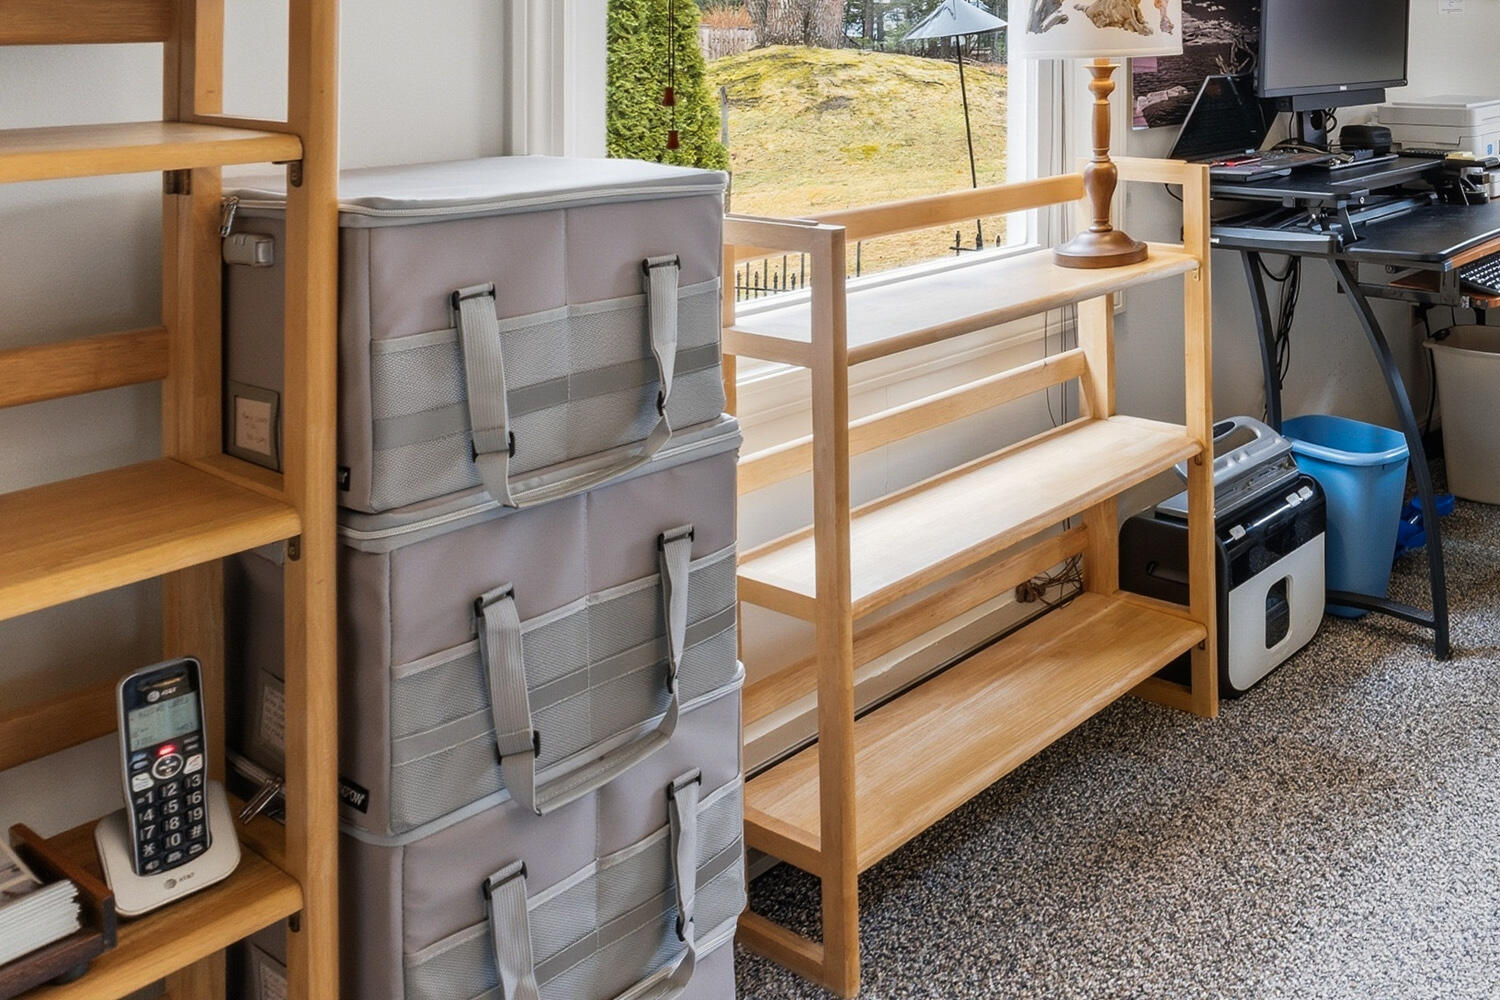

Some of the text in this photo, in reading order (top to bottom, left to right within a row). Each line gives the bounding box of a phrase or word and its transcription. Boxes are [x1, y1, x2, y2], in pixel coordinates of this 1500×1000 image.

[145, 774, 201, 804] 1 2 3
[144, 791, 202, 821] 4 5 6
[144, 807, 203, 839] 7 8 9
[171, 833, 181, 846] 0
